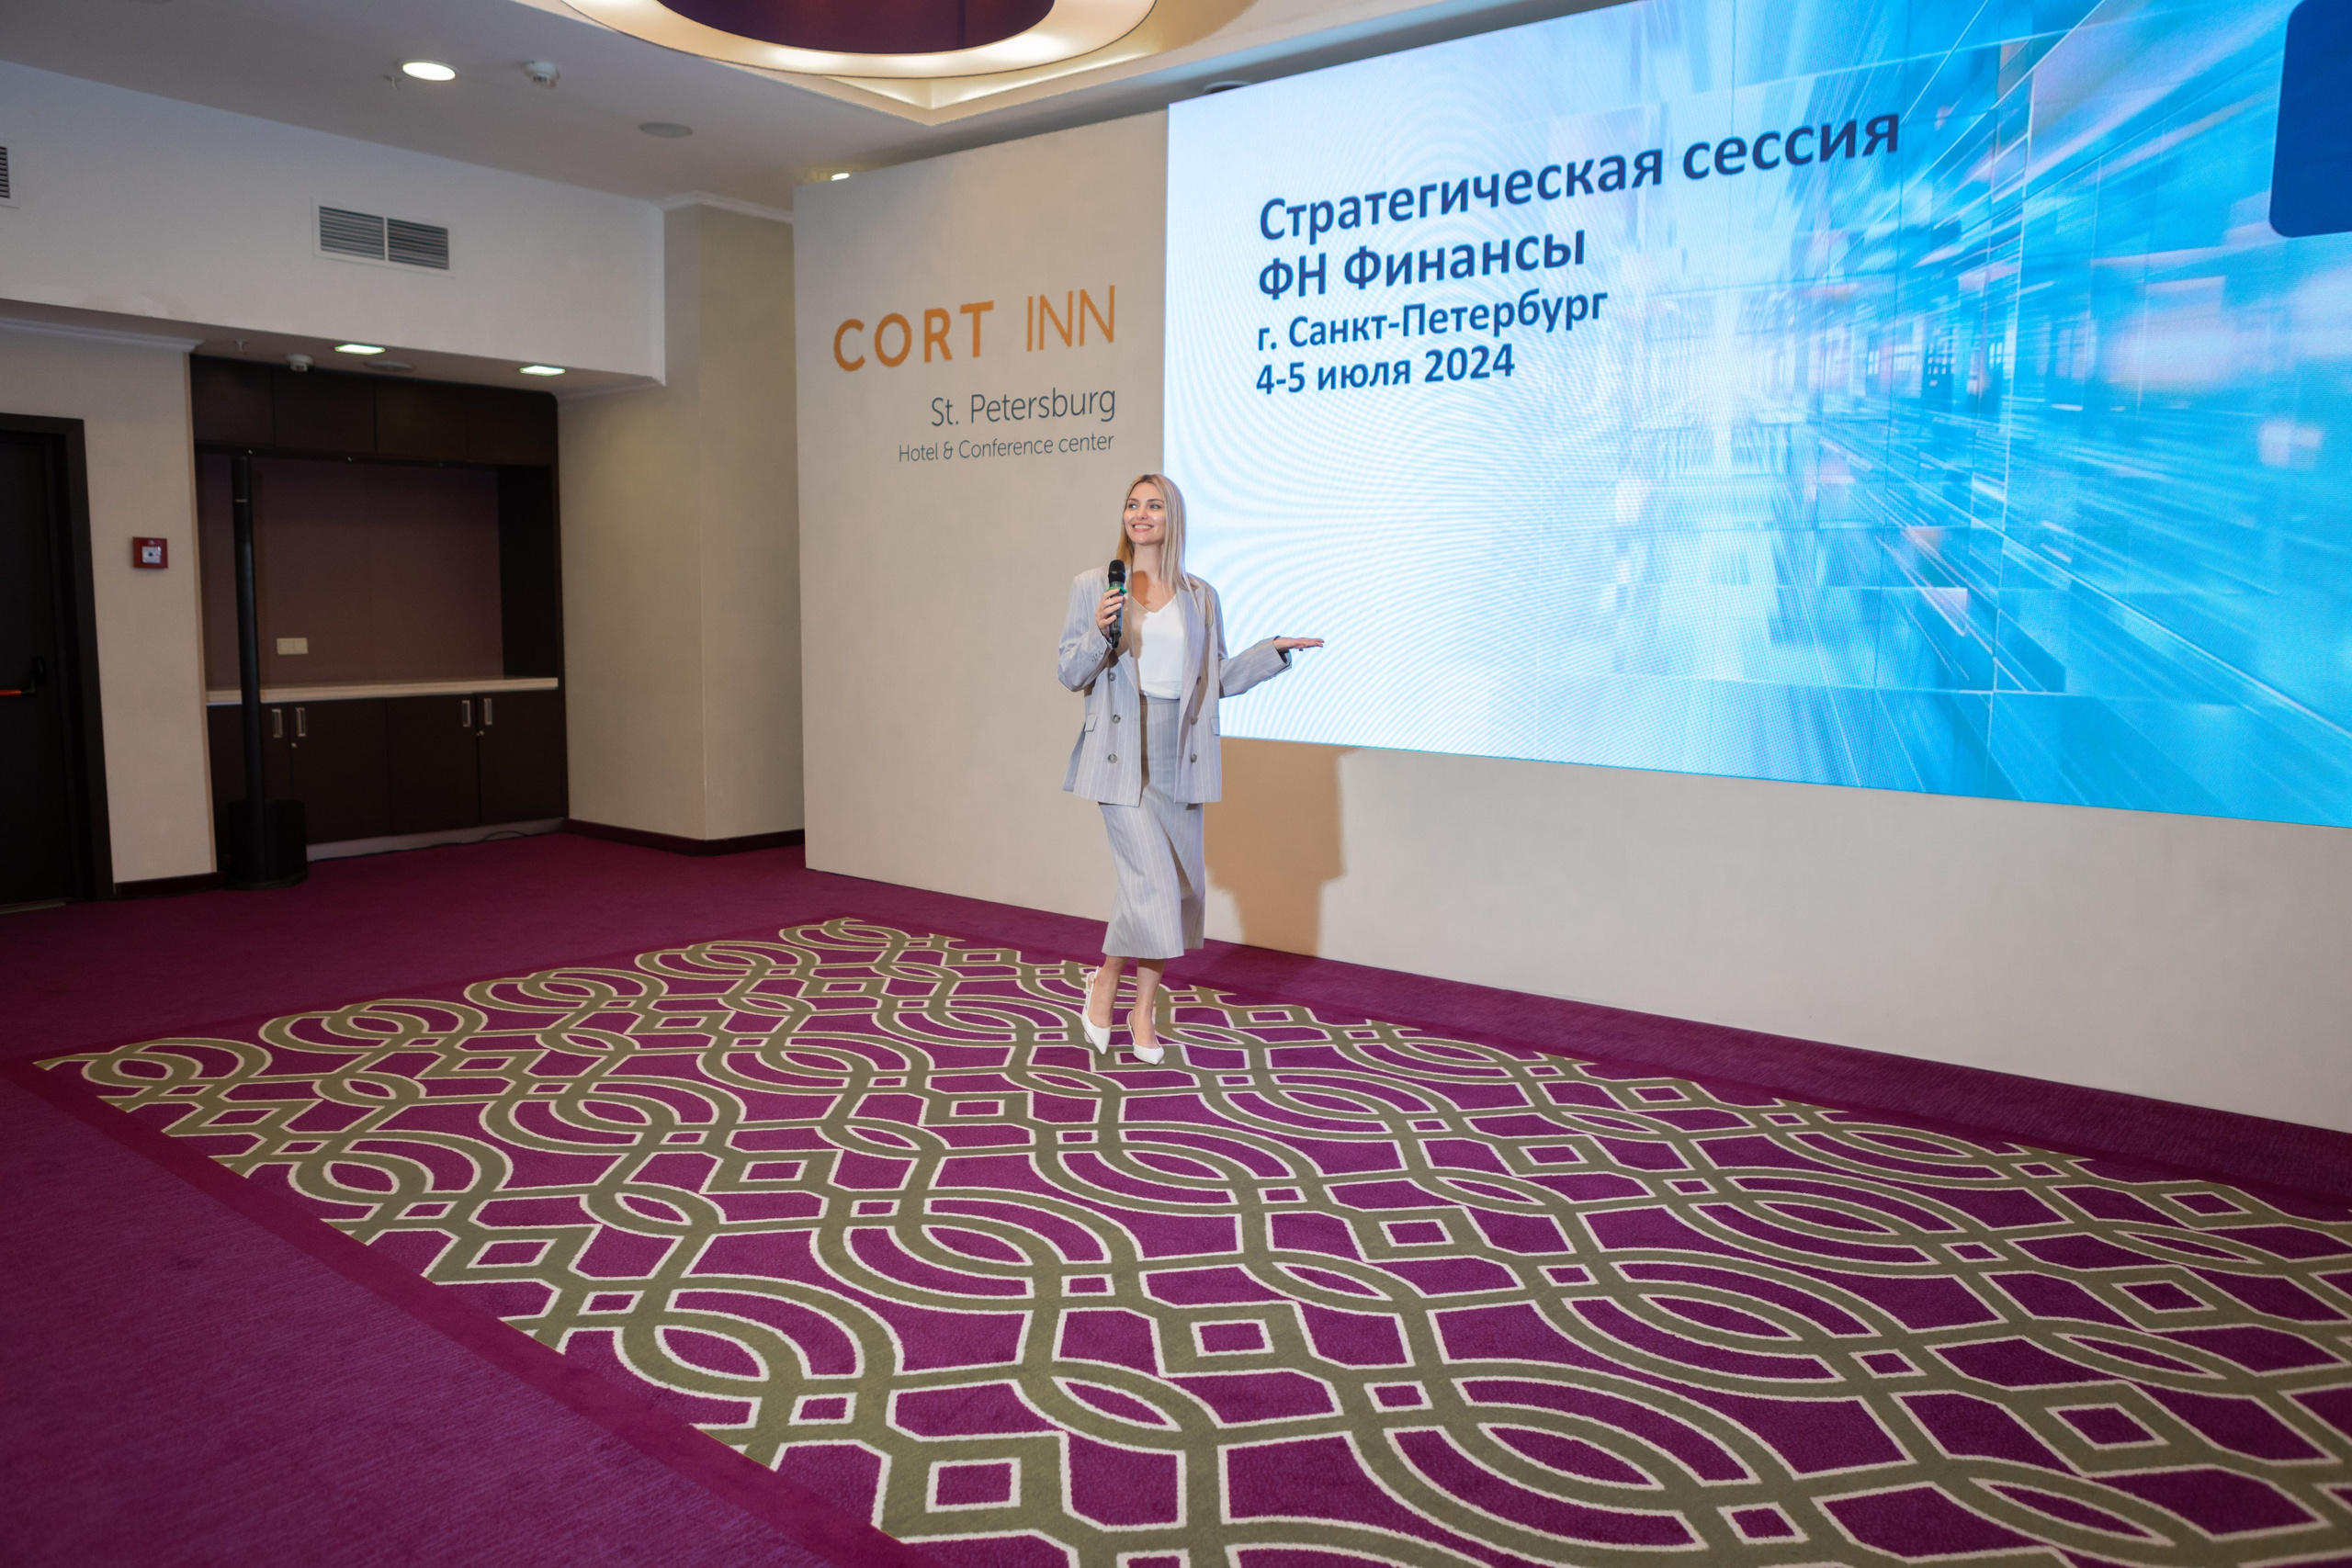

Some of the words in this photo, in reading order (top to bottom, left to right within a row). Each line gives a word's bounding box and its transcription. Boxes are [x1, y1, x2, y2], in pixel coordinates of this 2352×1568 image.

[1260, 148, 1663, 244] Стратегическая
[1682, 113, 1899, 180] сессия
[1259, 252, 1327, 300] ФН
[1344, 230, 1586, 290] Финансы
[833, 299, 995, 372] CORT
[1026, 284, 1115, 352] INN
[1258, 322, 1278, 351] г.
[1289, 287, 1608, 347] Санкт-Петербург
[1256, 361, 1306, 395] 4-5
[1317, 355, 1410, 391] июля
[1425, 343, 1515, 382] 2024
[931, 397, 959, 427] St.
[970, 387, 1115, 423] Petersburg
[899, 442, 939, 462] Hotel
[943, 441, 954, 459] &
[958, 437, 1054, 458] Conference
[1058, 432, 1114, 453] center
